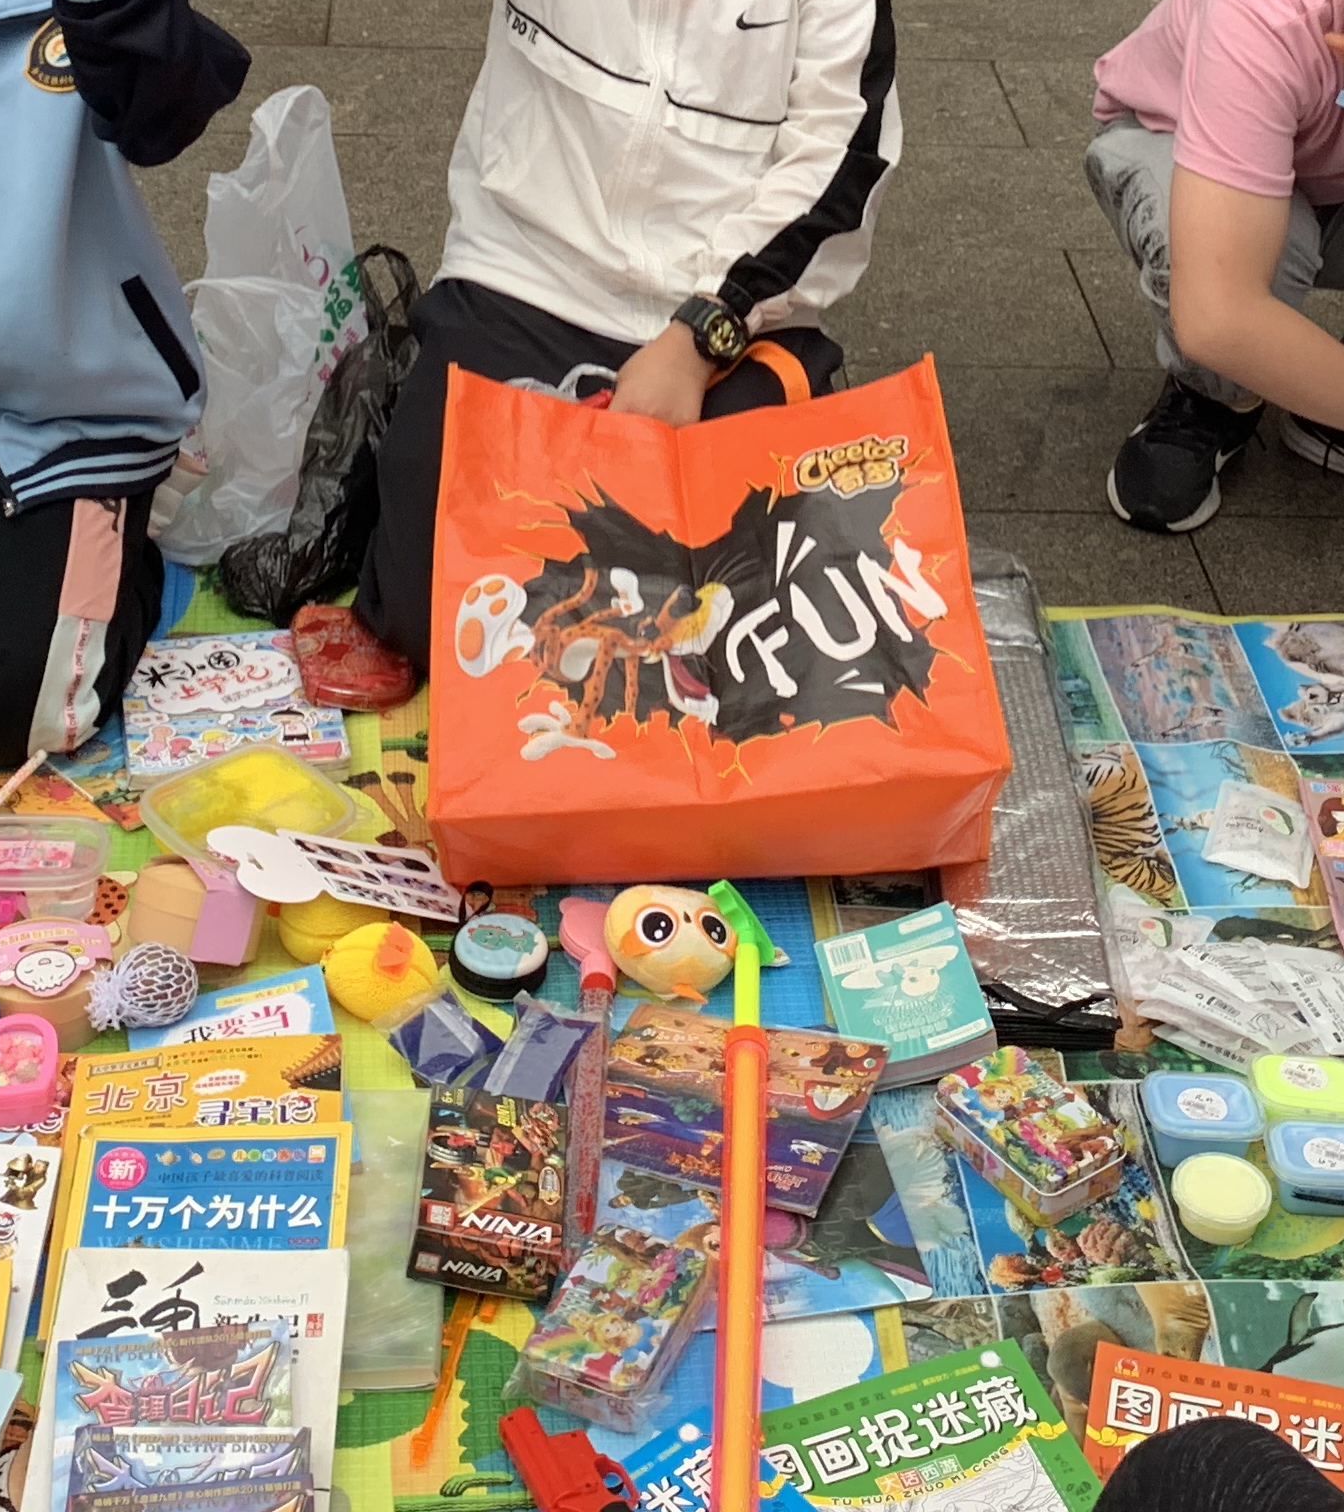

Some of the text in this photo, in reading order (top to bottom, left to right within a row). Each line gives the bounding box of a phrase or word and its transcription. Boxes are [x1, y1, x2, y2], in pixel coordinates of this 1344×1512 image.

[796, 436, 907, 488] Cheetos
[726, 538, 948, 699] FUN
[138, 650, 241, 689] 米小圈
[179, 664, 271, 701] 上学记
[184, 1004, 290, 1045] 我要当
[85, 1072, 190, 1116] 北京
[196, 1090, 320, 1126] 寻宝记
[109, 1159, 137, 1181] 新
[157, 1169, 325, 1185] 中国孩子最喜爱的科普阅读
[92, 1193, 324, 1230] 十万个为什么
[460, 1212, 553, 1244] NINJA
[441, 1259, 503, 1282] NINJA
[69, 1340, 280, 1426] 查理日记
[145, 1443, 227, 1455] DETECTIVE
[231, 1443, 278, 1455] DIARY
[761, 1374, 1038, 1495] 图画捉迷藏
[831, 1446, 1010, 1506] TU HUA ZHUO MI CANG
[875, 1453, 961, 1494] 大话西游
